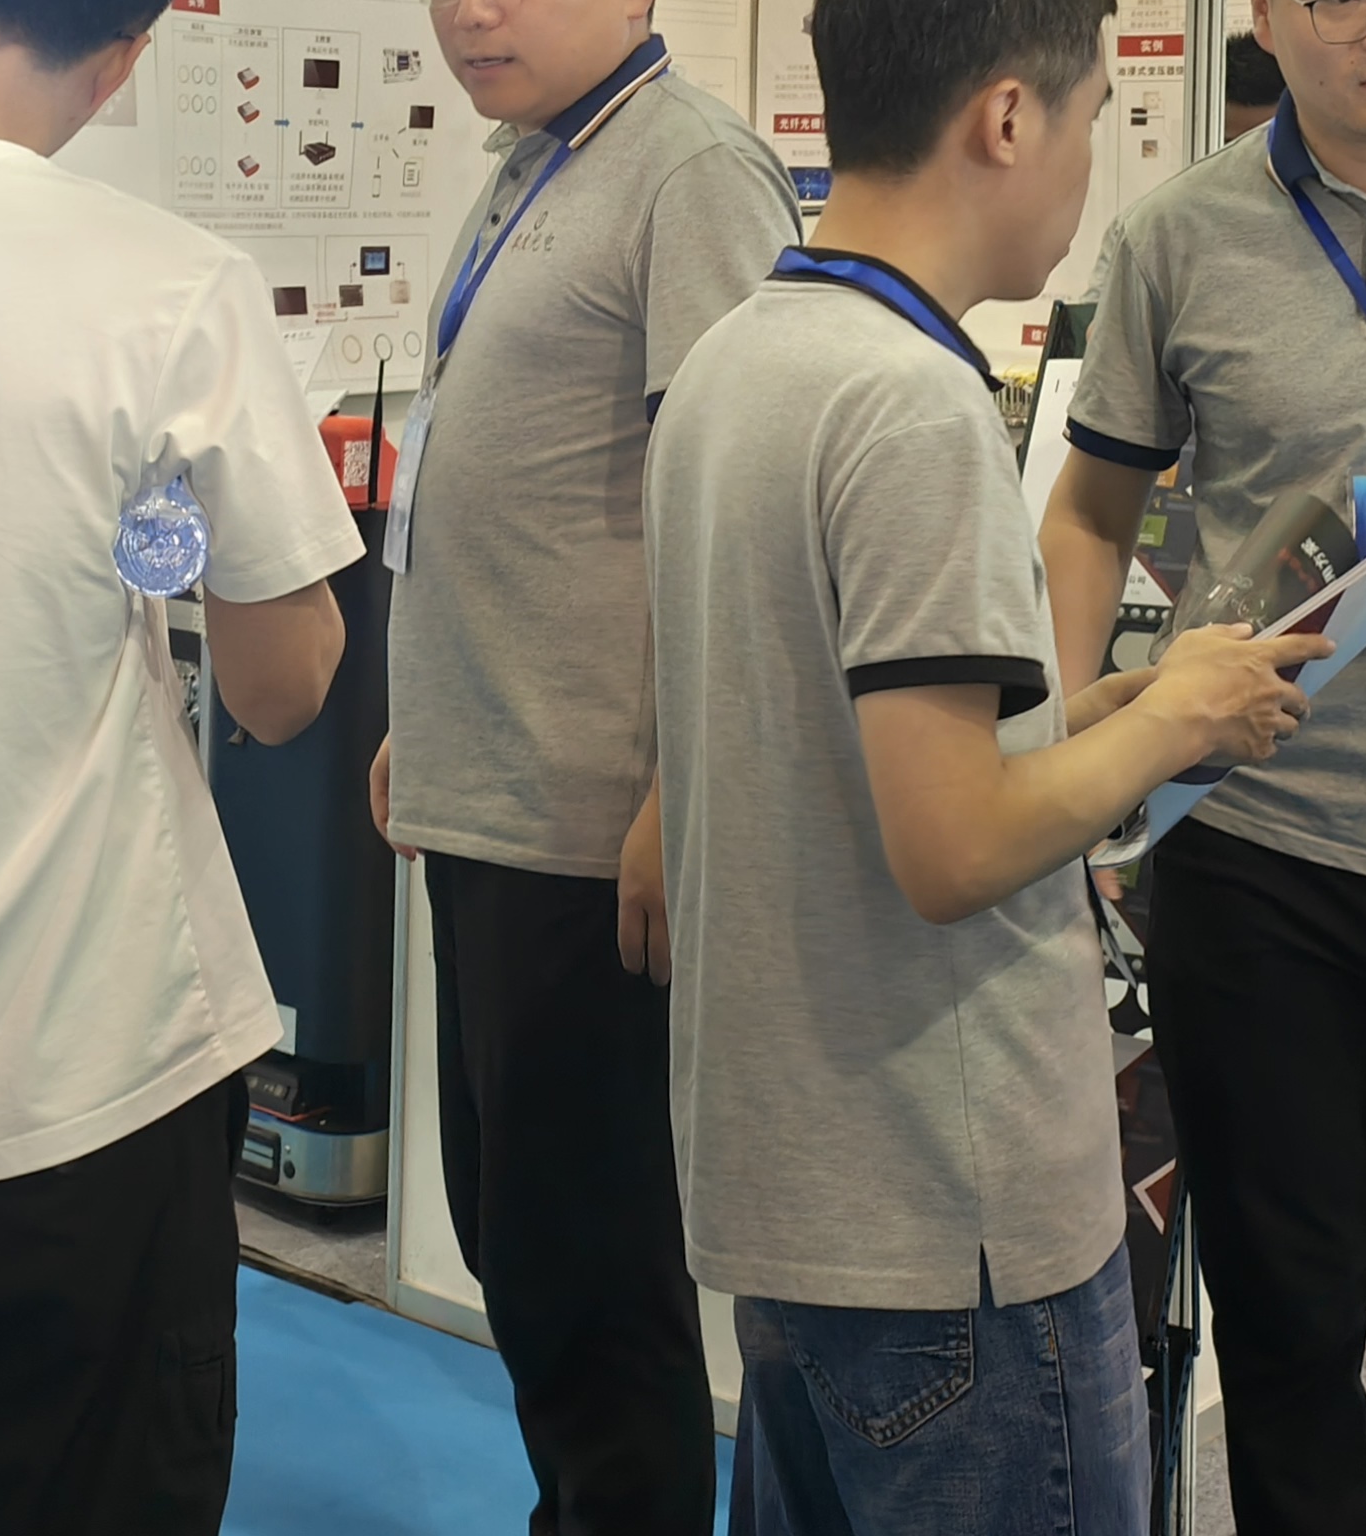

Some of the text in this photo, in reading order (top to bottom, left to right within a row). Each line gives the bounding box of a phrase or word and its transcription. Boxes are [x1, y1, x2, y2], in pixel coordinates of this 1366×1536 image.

[1140, 40, 1164, 53] 实例
[779, 117, 825, 131] 光纤光栅
